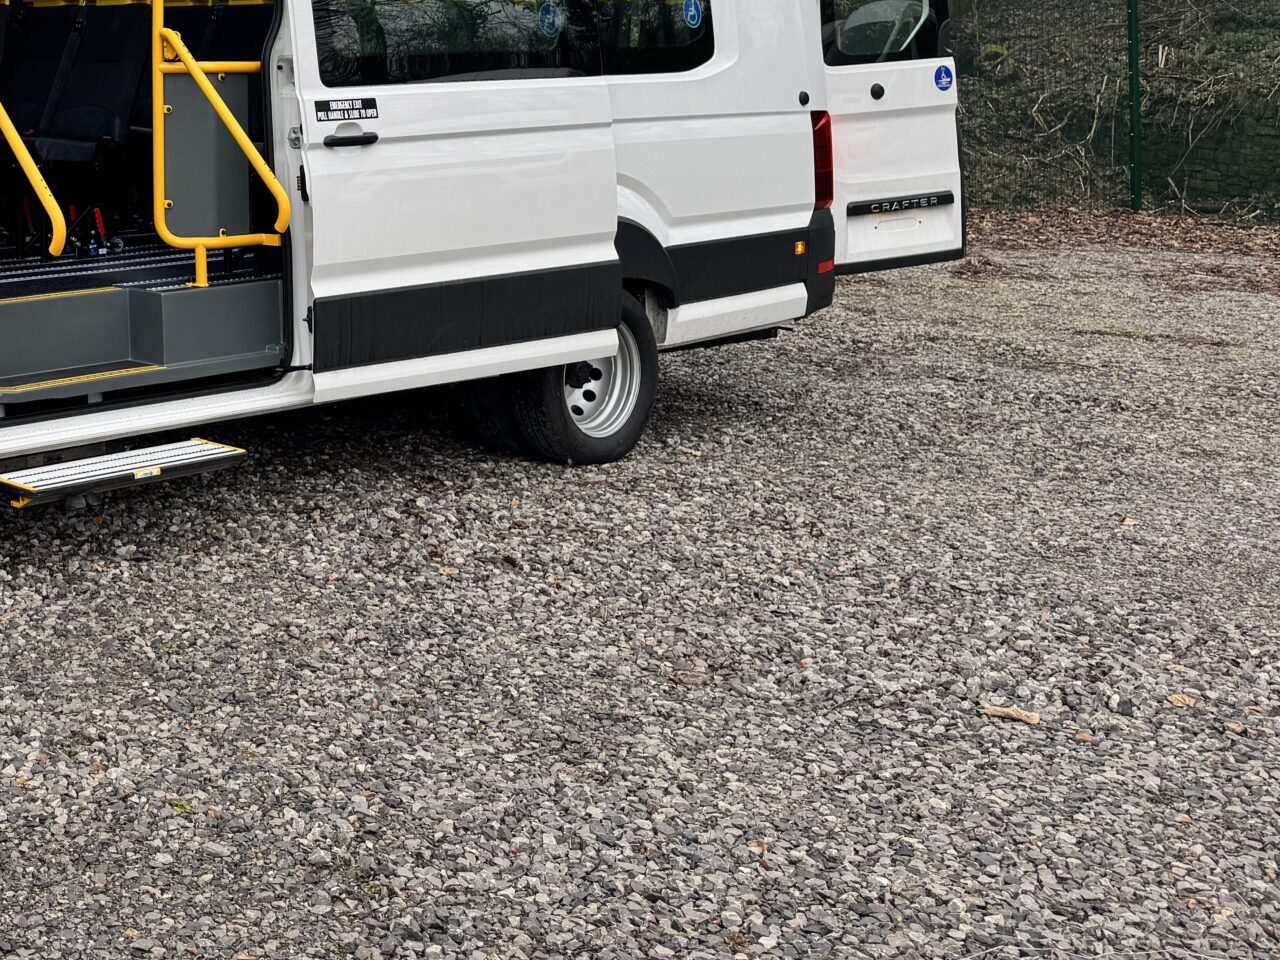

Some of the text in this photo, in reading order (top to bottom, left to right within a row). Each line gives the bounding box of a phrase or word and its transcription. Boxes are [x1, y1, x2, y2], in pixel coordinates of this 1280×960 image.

[353, 100, 362, 109] EXIT
[317, 112, 327, 120] PULL
[328, 110, 344, 120] HANDLE
[349, 109, 360, 119] SLIDE
[360, 109, 366, 118] TO
[366, 109, 377, 117] OPEN
[871, 197, 938, 212] CRAFTER
